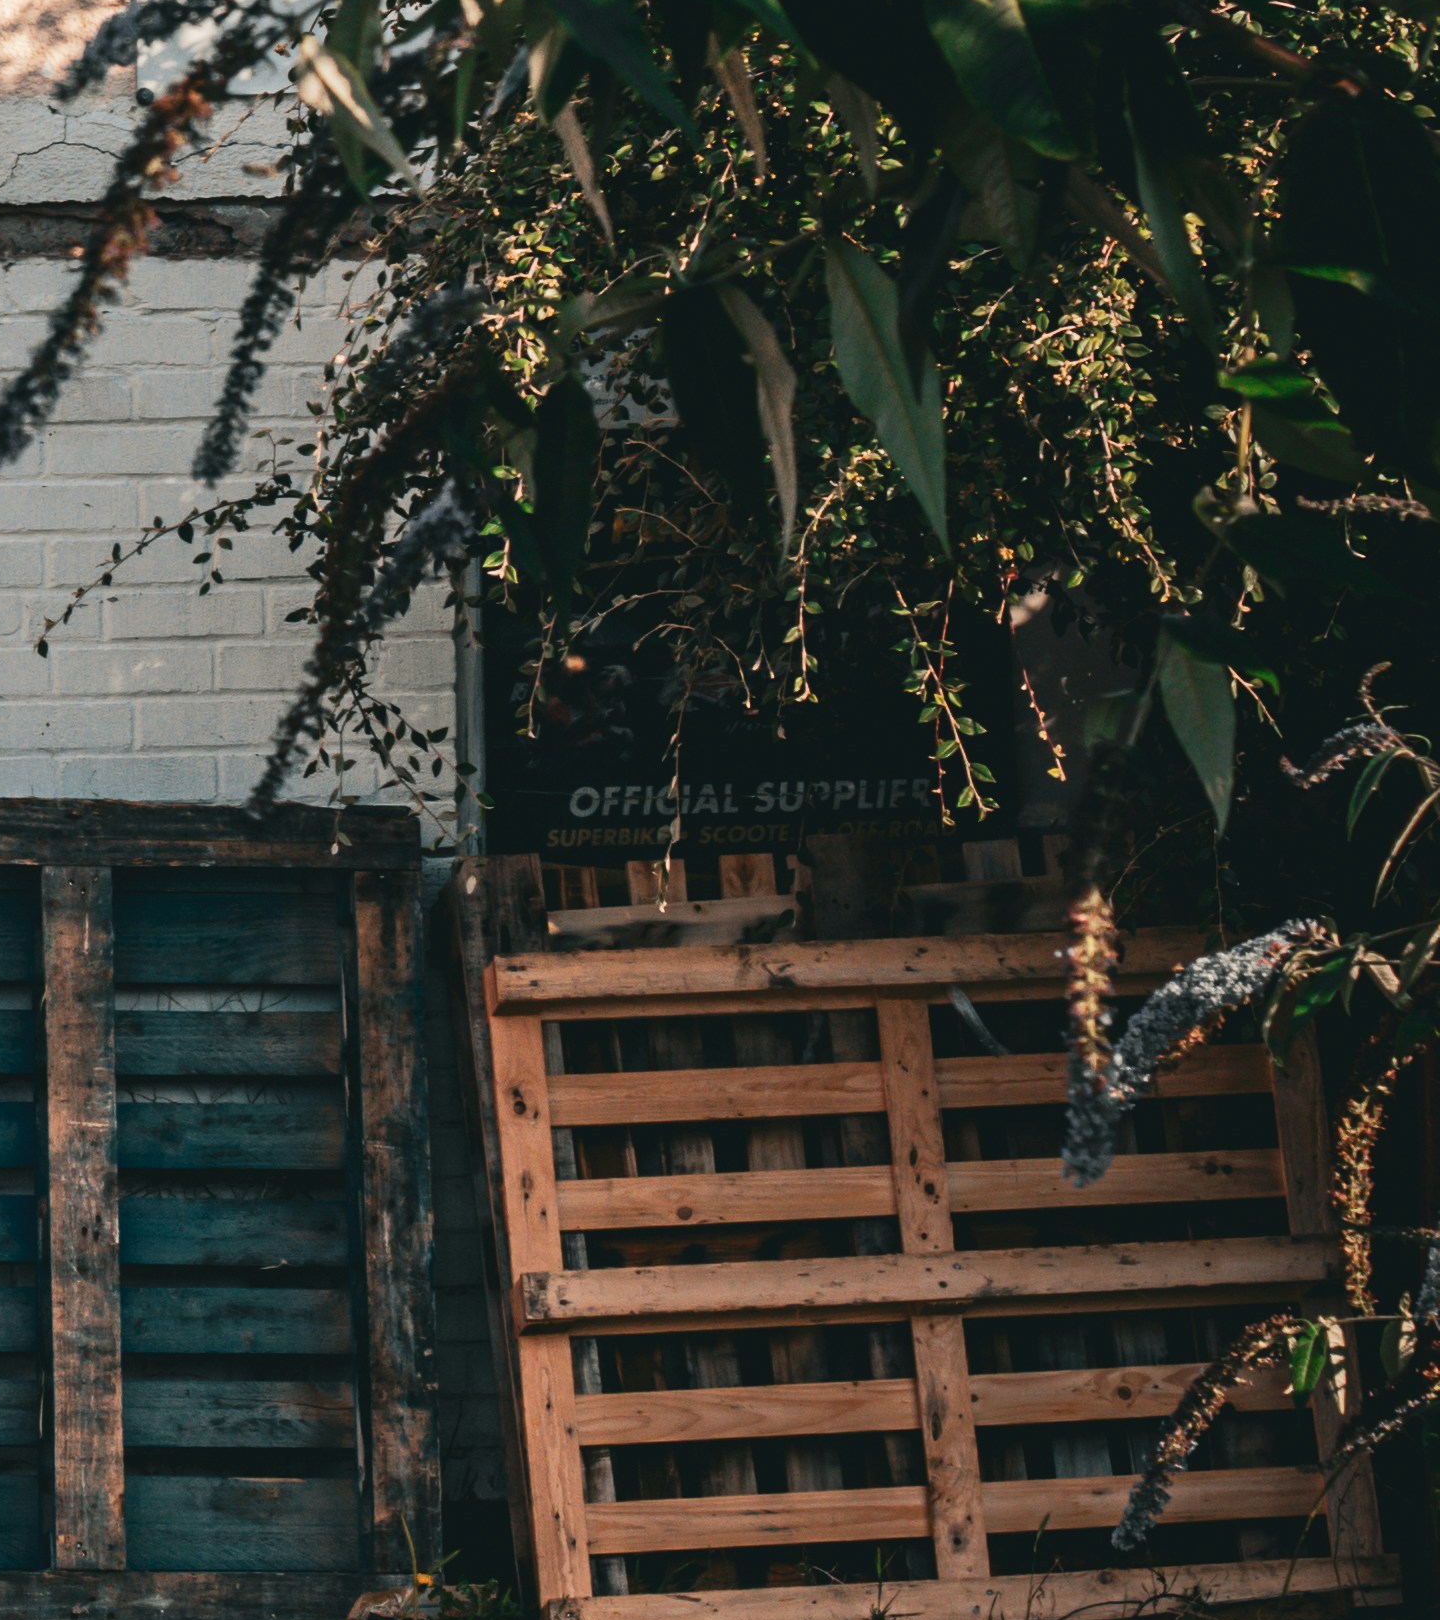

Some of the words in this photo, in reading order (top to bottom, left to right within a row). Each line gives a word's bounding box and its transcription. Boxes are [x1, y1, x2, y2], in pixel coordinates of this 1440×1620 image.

[569, 783, 739, 818] OFFICIAL
[754, 778, 931, 813] SUPPLIER
[697, 824, 802, 844] SCOOTE
